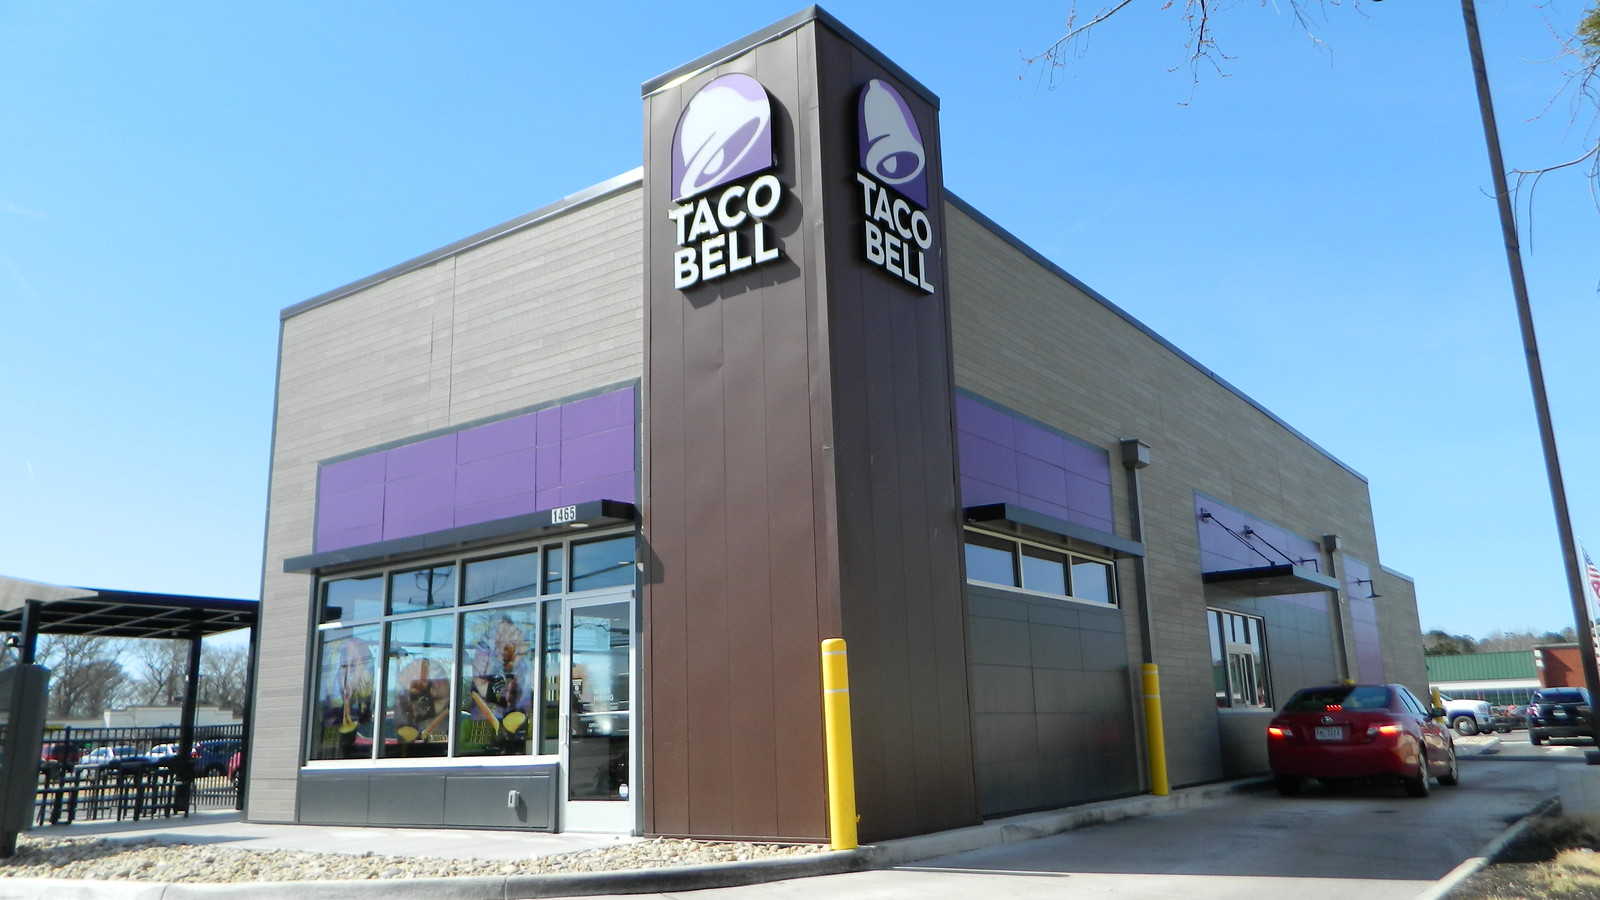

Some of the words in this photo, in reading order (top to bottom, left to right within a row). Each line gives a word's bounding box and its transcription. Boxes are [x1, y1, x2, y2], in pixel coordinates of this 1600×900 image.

[668, 174, 781, 246] TACO
[857, 172, 932, 249] TACO
[674, 223, 779, 289] BELL
[865, 221, 935, 294] BELL
[553, 507, 575, 522] 1465
